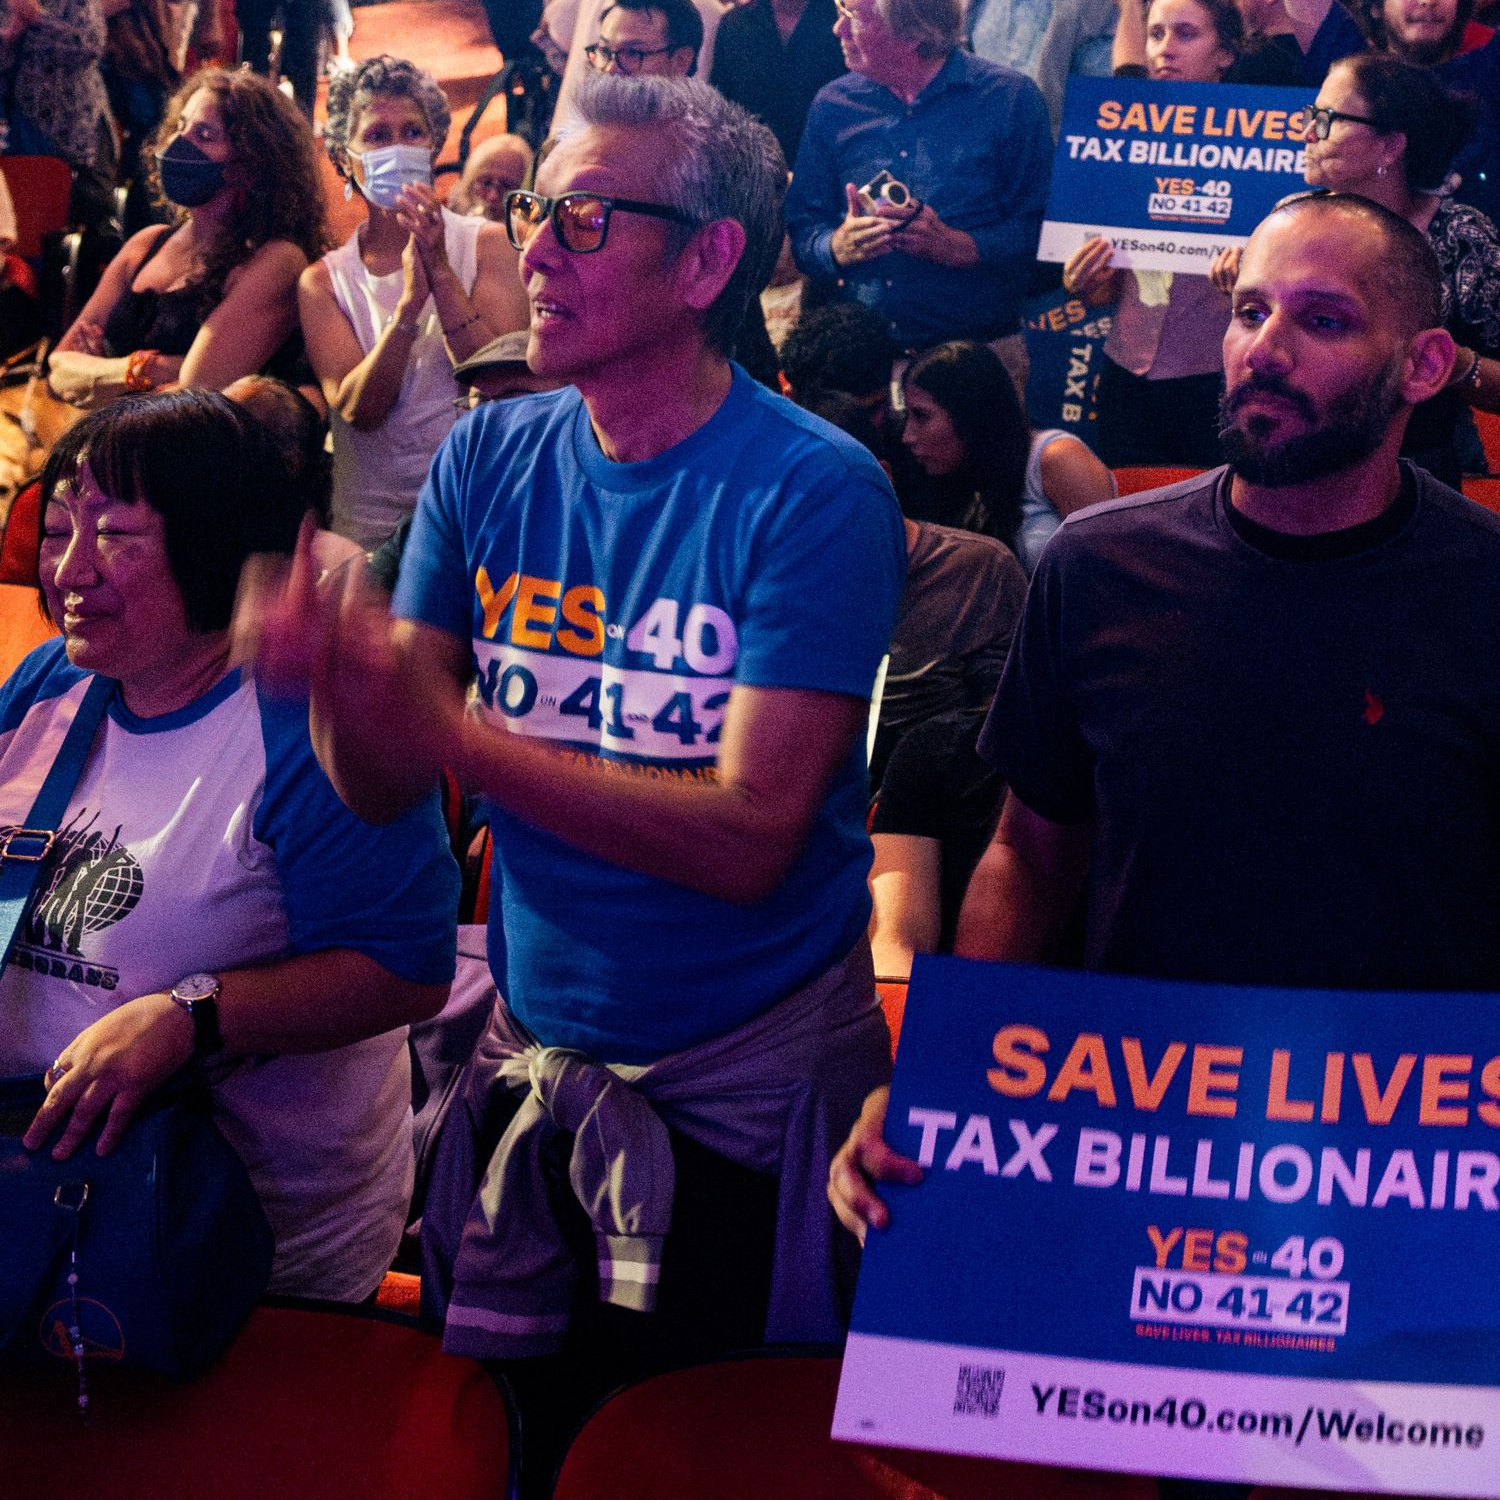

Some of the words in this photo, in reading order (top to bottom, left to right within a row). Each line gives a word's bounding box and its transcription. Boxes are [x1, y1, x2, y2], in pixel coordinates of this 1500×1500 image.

[1097, 100, 1197, 136] SAVE
[1203, 106, 1306, 142] LIVES
[1066, 135, 1125, 163] TAX
[1129, 140, 1307, 174] BILLIONAIRE
[1153, 198, 1176, 210] NO
[1182, 199, 1201, 212] 41
[1207, 201, 1228, 214] 42
[1154, 177, 1195, 196] YES
[1201, 179, 1231, 197] 40
[1064, 343, 1093, 399] TAX
[475, 565, 606, 657] YES
[627, 598, 739, 676] 40
[476, 656, 538, 718] NO
[559, 676, 635, 740] 41
[653, 692, 731, 746] 42
[985, 1023, 1243, 1119] SAVE
[908, 1107, 1058, 1183] TAX
[1146, 1224, 1249, 1276] YES
[1271, 1235, 1344, 1280] 40
[1139, 1278, 1203, 1313] NO
[1216, 1286, 1272, 1321] 41
[1285, 1290, 1342, 1323] 42
[1136, 1323, 1170, 1340] SAVE
[1216, 1329, 1241, 1345] TAX
[1032, 1383, 1485, 1450] YESon40.com/Welcome
